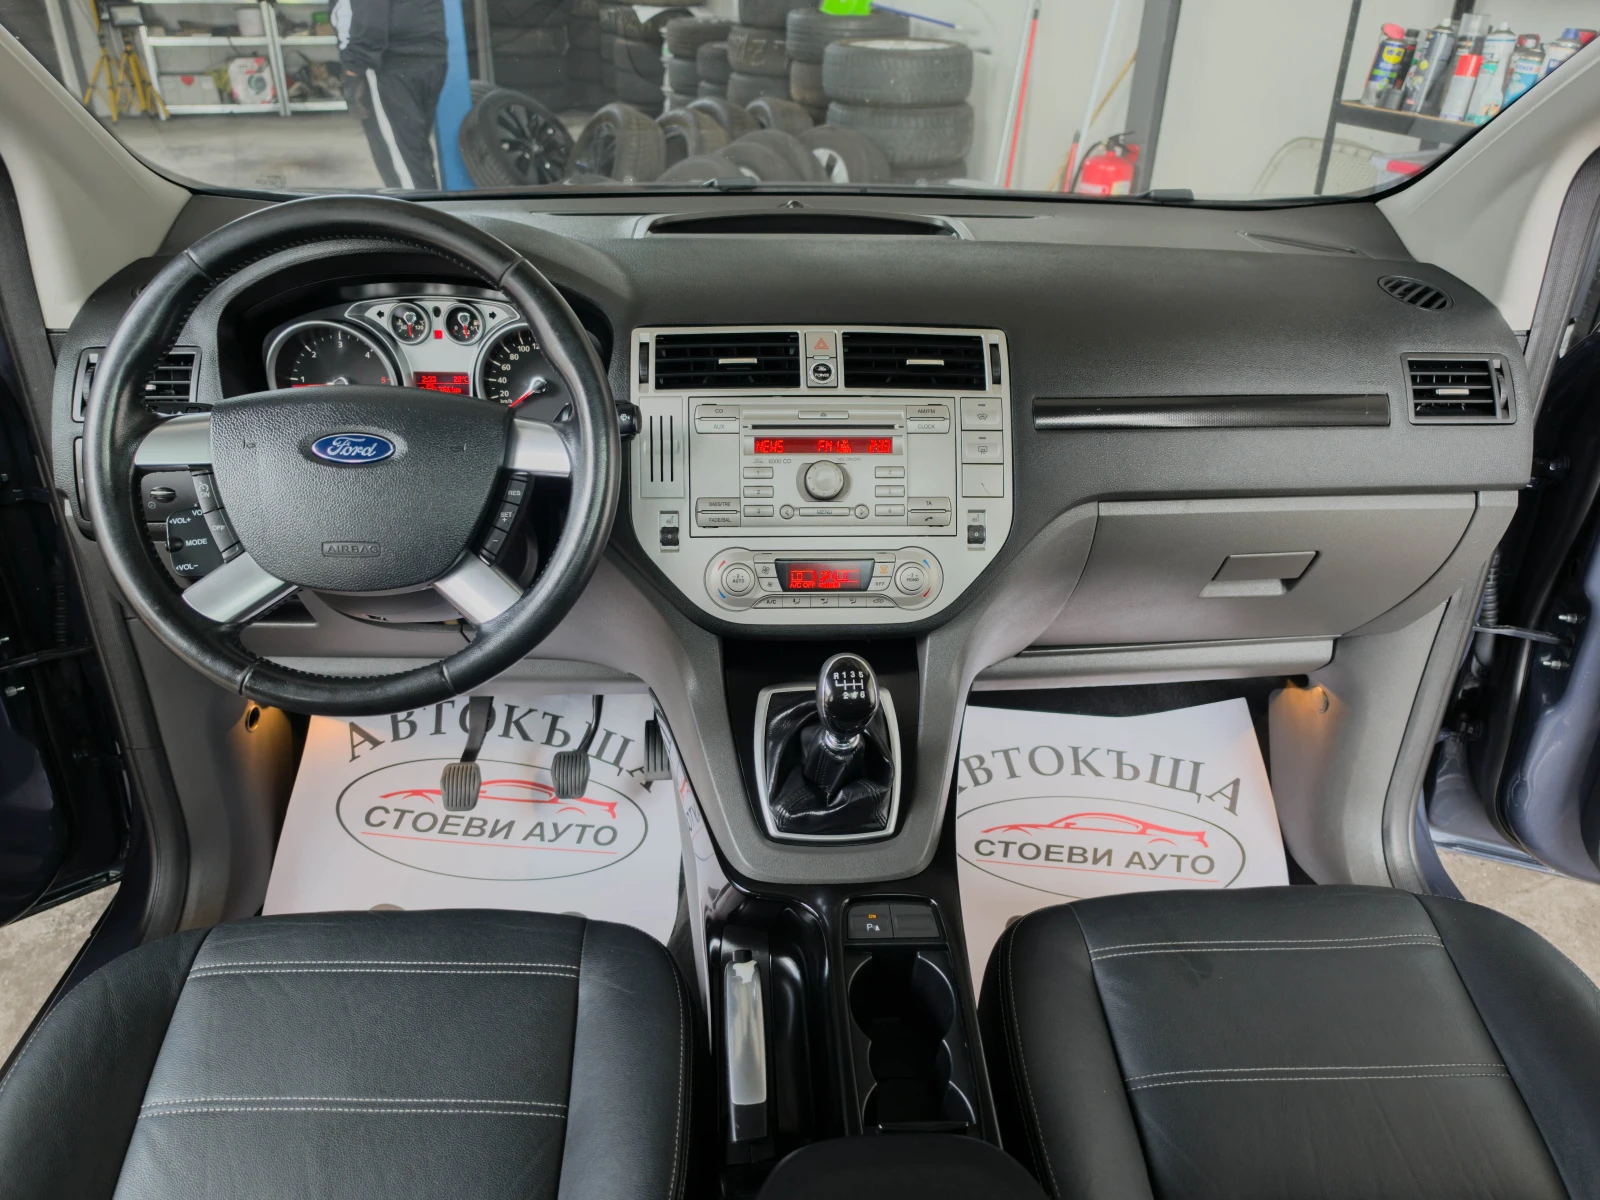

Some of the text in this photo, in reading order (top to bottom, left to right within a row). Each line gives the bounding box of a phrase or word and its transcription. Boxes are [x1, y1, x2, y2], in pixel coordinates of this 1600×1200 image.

[517, 345, 531, 353] 100
[311, 351, 317, 359] 2
[365, 351, 371, 359] 4
[509, 353, 520, 361] 80
[501, 363, 511, 371] 60
[381, 376, 386, 384] 5
[326, 436, 378, 456] Ford
[755, 439, 785, 453] NEWS
[817, 439, 833, 453] FM
[191, 509, 203, 517] VO
[172, 517, 192, 525] VOL+
[211, 524, 225, 532] OFF
[185, 538, 208, 547] MODE
[327, 544, 379, 554] AIRBAG
[833, 672, 840, 680] R
[842, 671, 847, 679] 1
[850, 670, 856, 678] 3
[843, 691, 849, 700] 2
[860, 690, 866, 699] 6
[957, 745, 1242, 816] ВТОКЪЩА
[363, 805, 618, 847] СТОЕВИ АУТО
[974, 839, 1215, 876] СТОЕВИ АУТО
